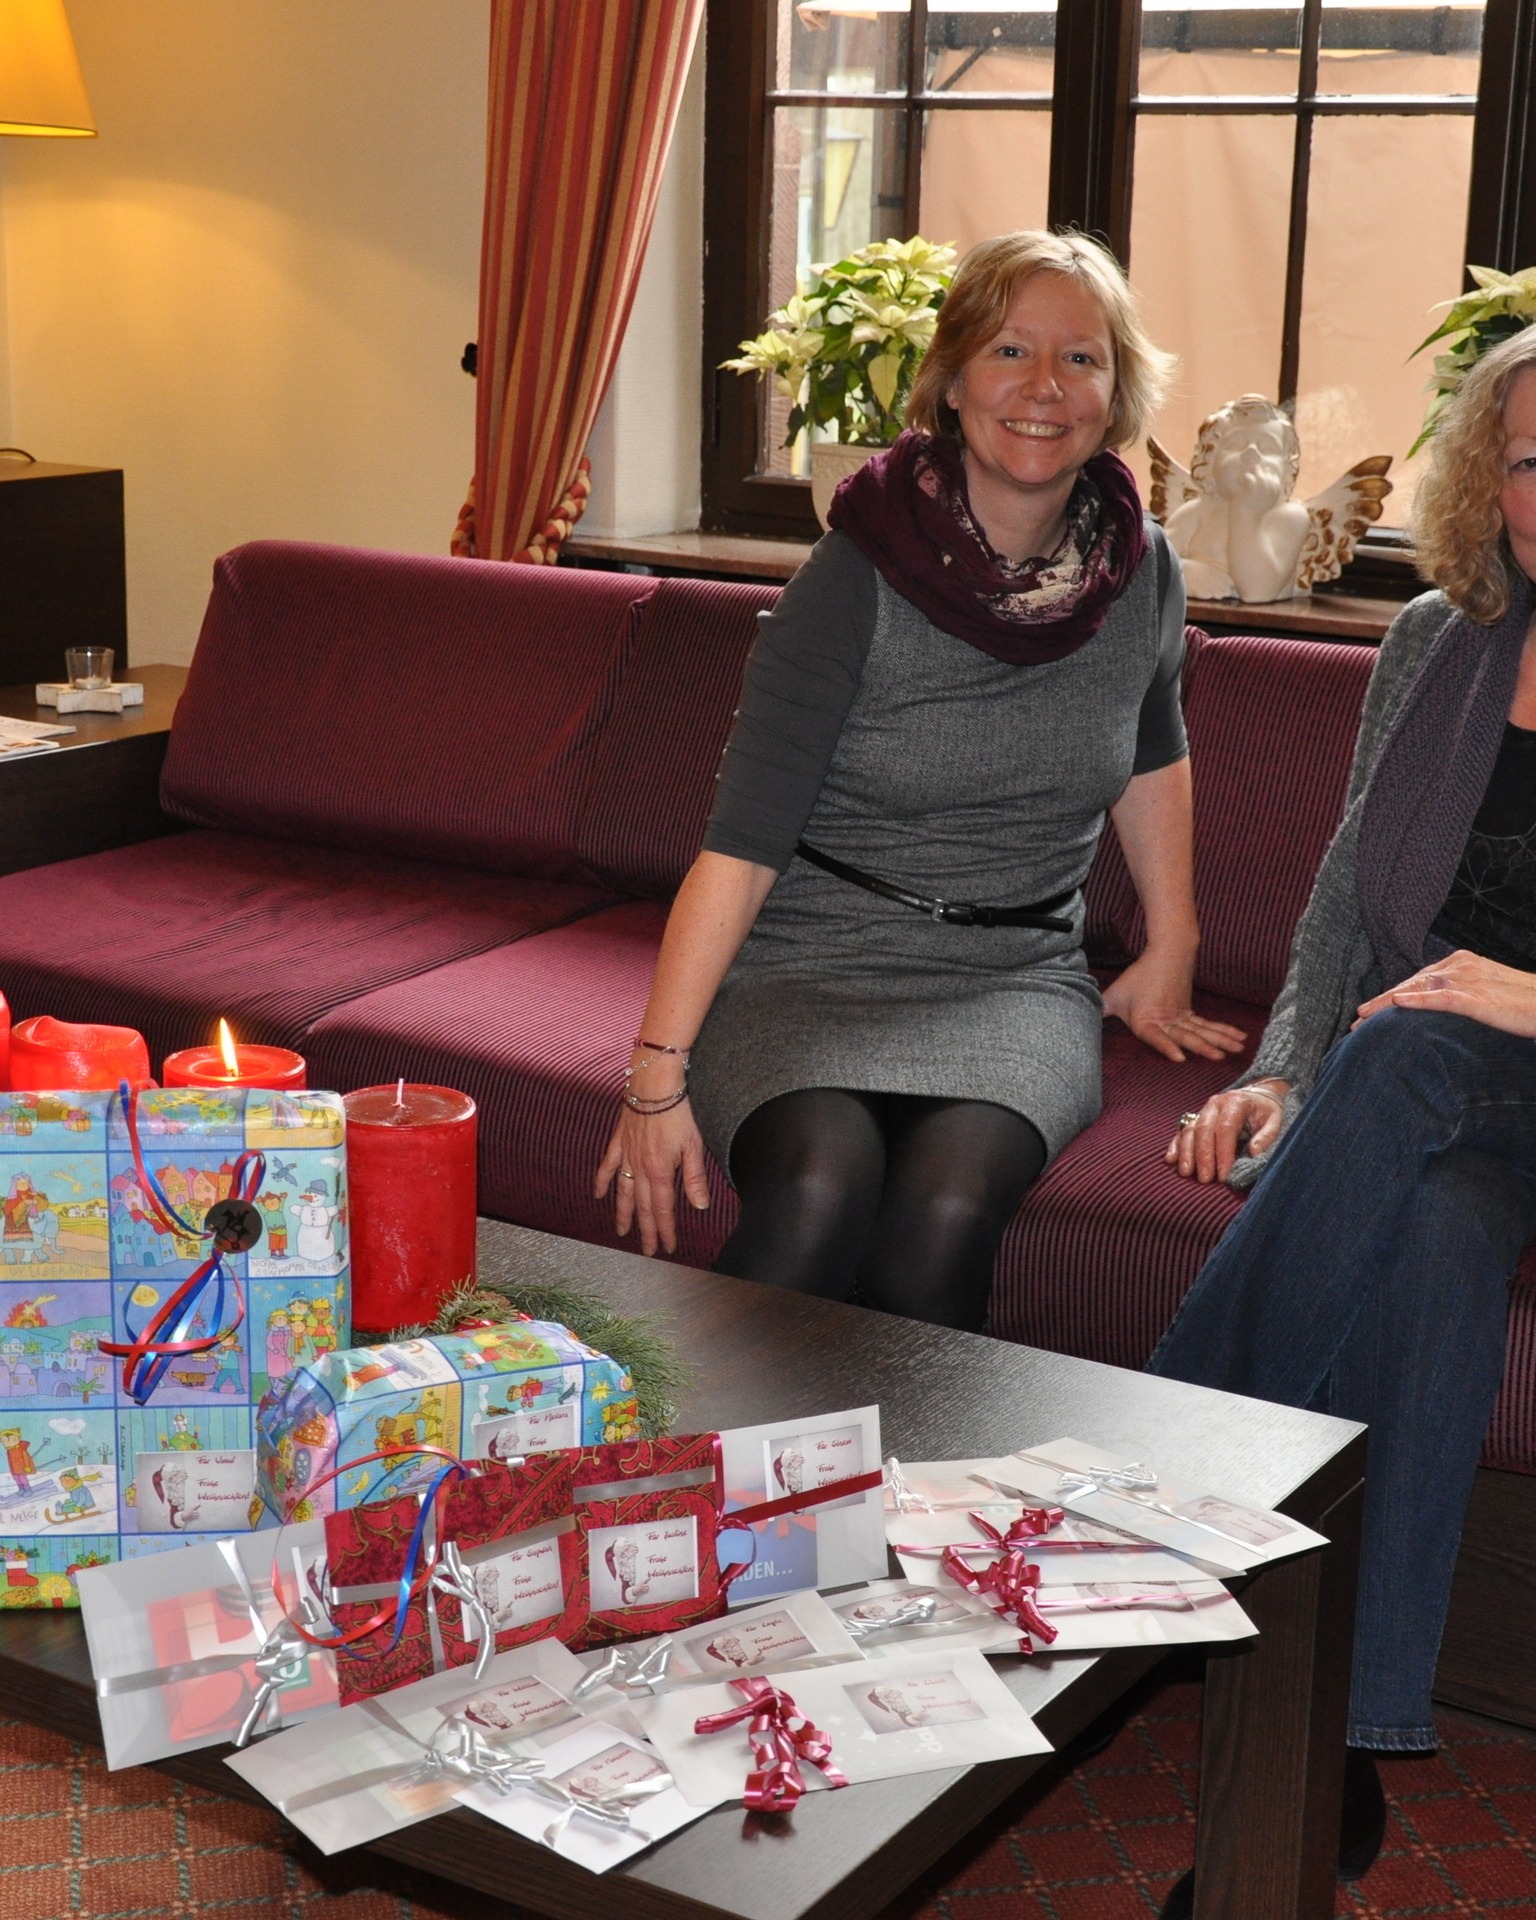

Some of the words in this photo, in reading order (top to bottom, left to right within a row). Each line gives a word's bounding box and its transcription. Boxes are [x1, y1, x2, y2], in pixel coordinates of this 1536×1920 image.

[526, 1415, 539, 1425] Für
[527, 1437, 547, 1447] Frohe
[814, 1441, 828, 1450] Für
[195, 1455, 211, 1465] Für
[816, 1463, 835, 1472] Frohe
[196, 1478, 219, 1488] Frohe
[198, 1491, 251, 1502] Weihnachten!
[10, 1510, 39, 1522] NEIGE
[645, 1531, 660, 1541] Für
[510, 1551, 523, 1562] Für
[646, 1554, 668, 1564] Frohe
[647, 1565, 695, 1578] Weihnachten!
[733, 1560, 793, 1582] DEN...
[512, 1574, 532, 1586] Frohe
[514, 1579, 559, 1600] Weihnachten!
